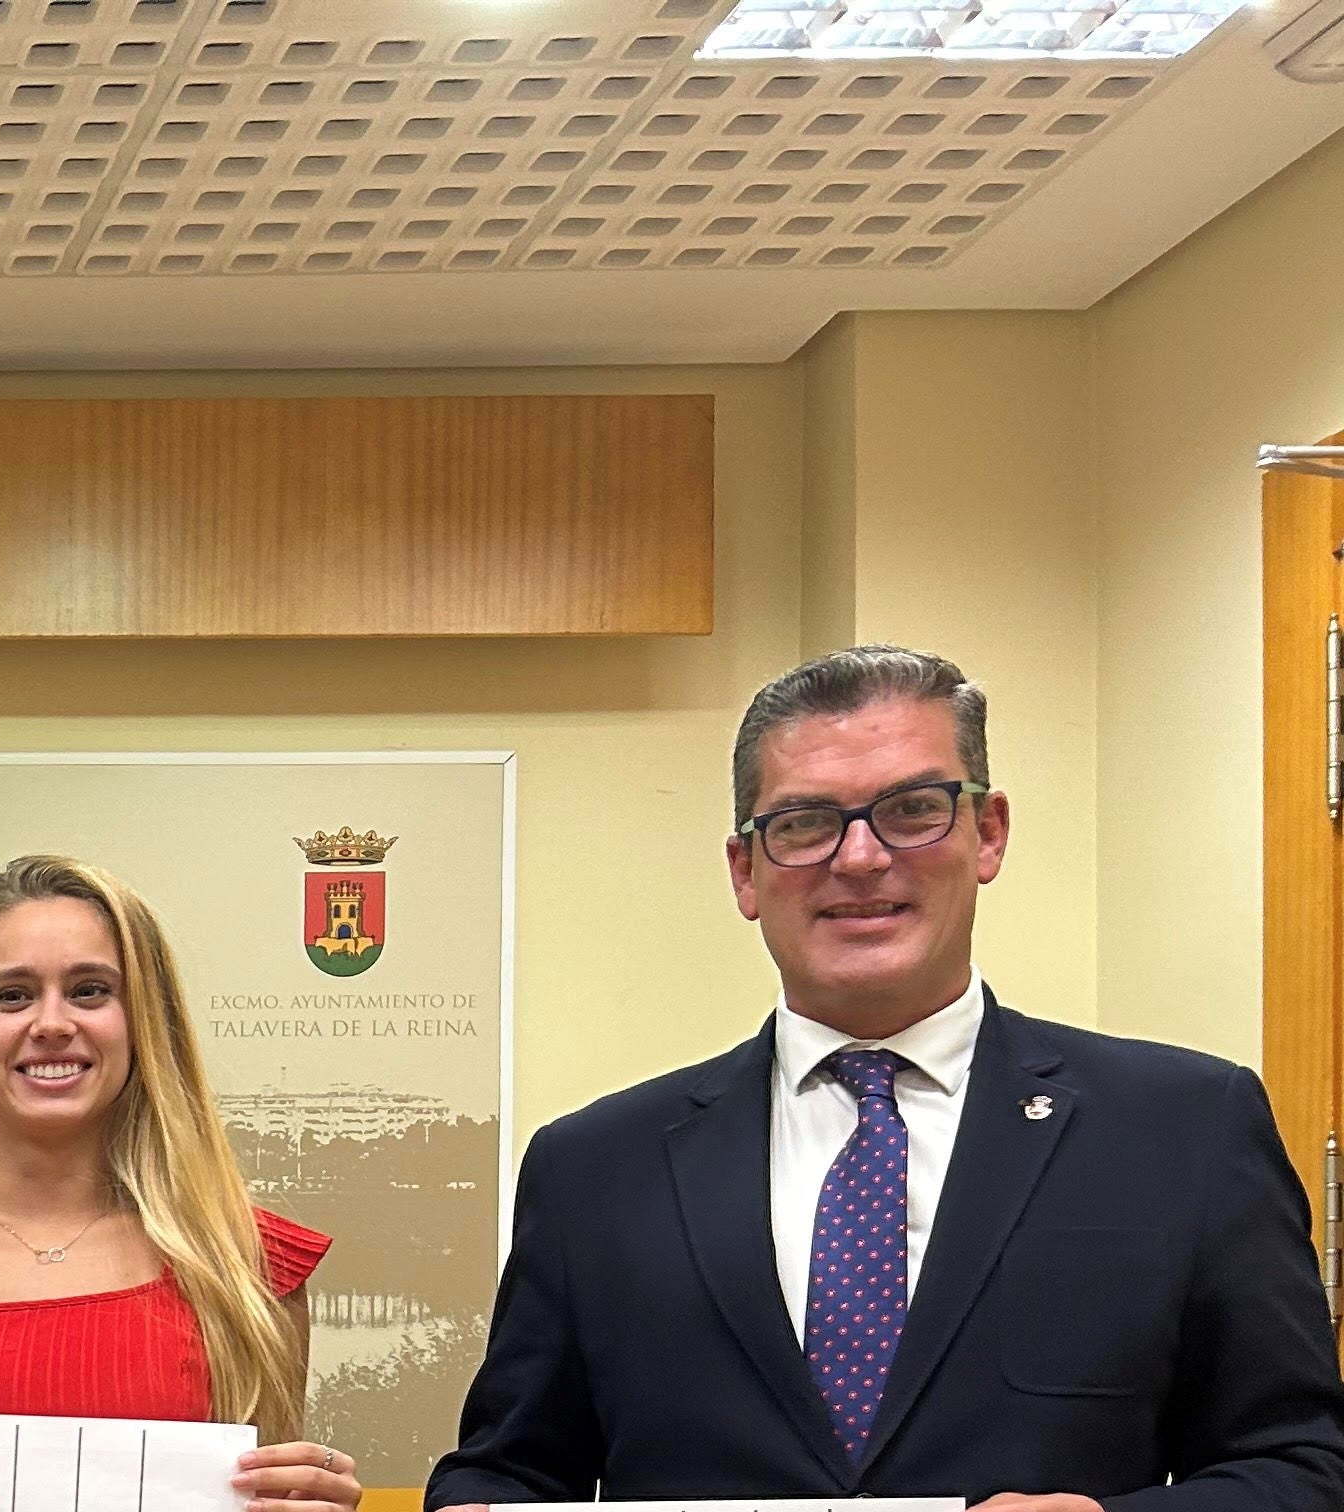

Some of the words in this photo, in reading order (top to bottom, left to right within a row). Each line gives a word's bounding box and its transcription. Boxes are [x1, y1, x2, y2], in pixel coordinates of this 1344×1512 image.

[210, 995, 282, 1010] EXCMO.
[290, 994, 445, 1009] AYUNTAMIENTO
[453, 994, 477, 1009] DE
[211, 1020, 322, 1038] TALAVERA
[332, 1020, 361, 1037] DE
[372, 1020, 397, 1037] LA
[407, 1020, 478, 1037] REINA
